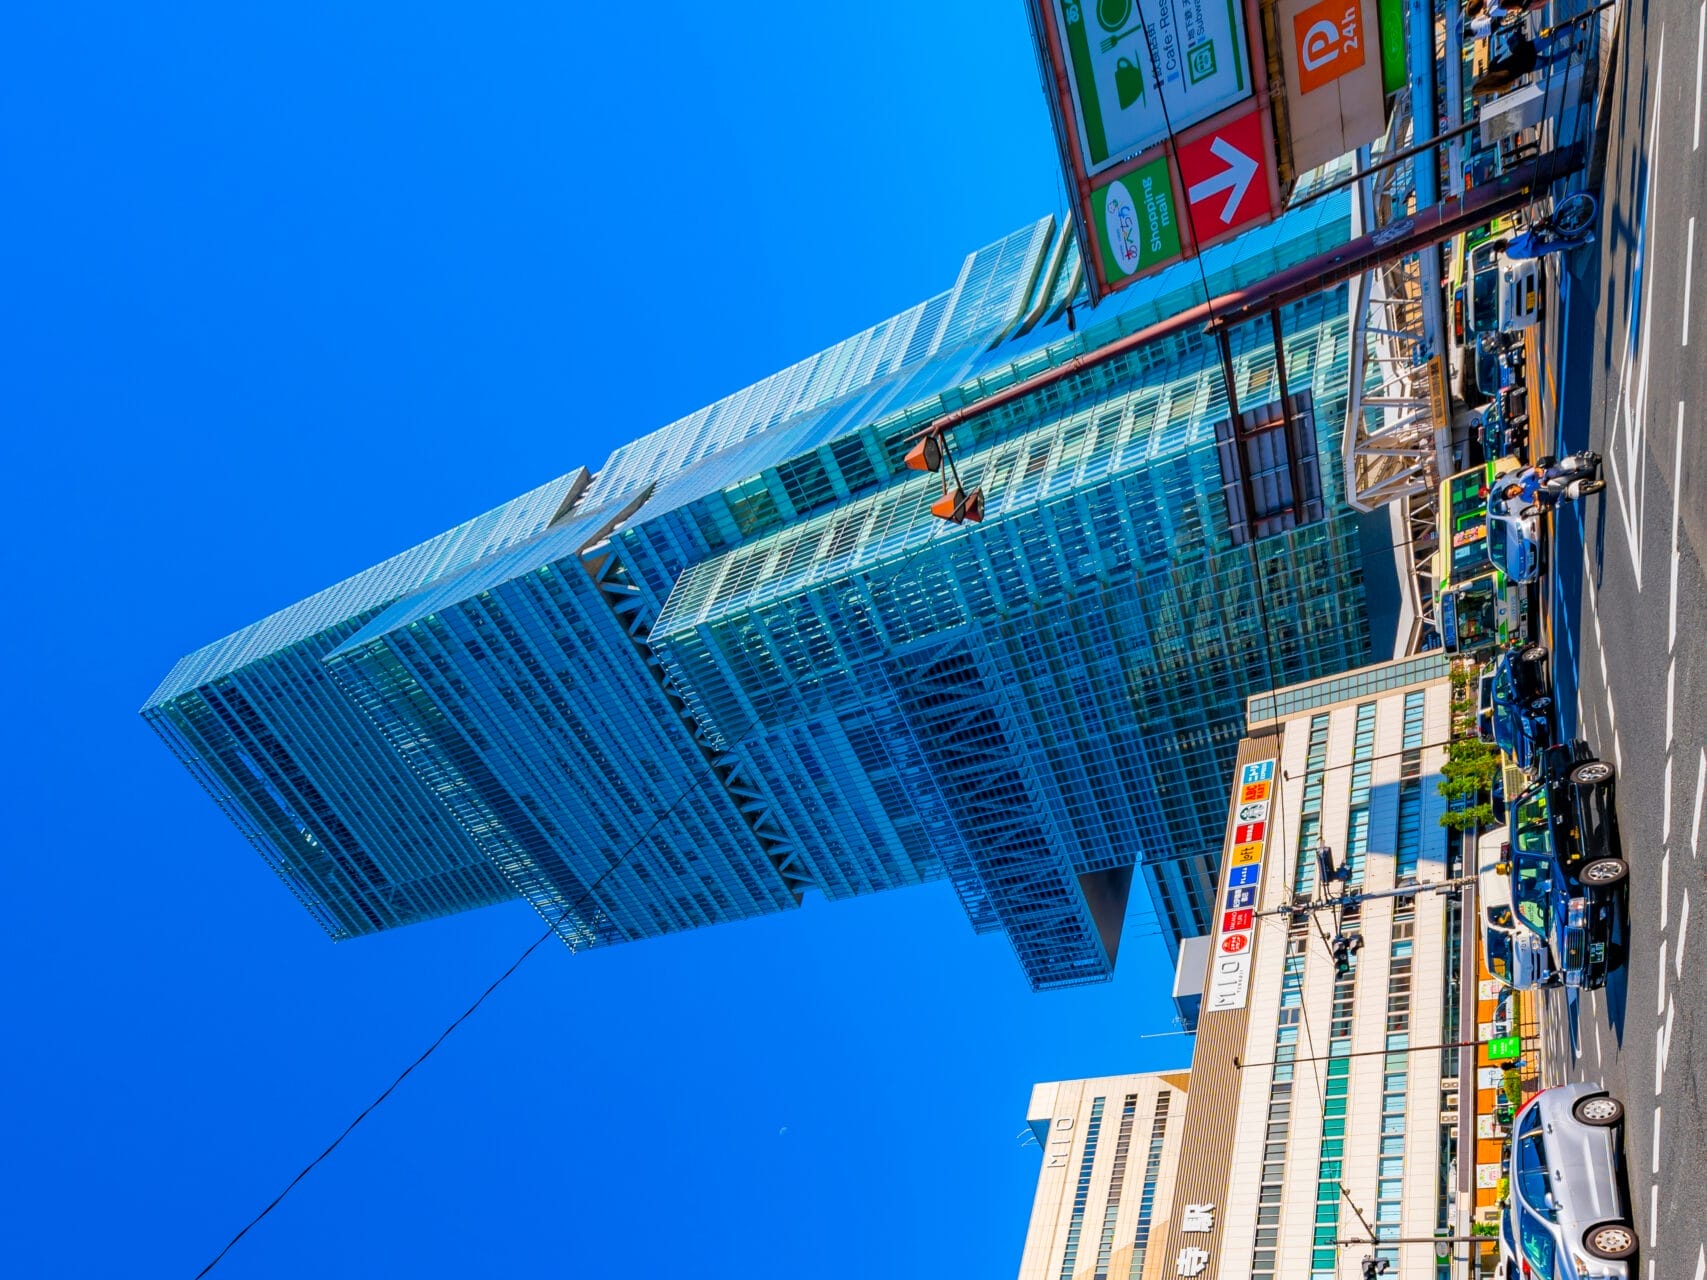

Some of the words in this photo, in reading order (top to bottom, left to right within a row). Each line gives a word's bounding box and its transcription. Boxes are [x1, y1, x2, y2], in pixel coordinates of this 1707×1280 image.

[1341, 7, 1358, 53] 24h
[1142, 176, 1162, 252] Shopping
[1155, 193, 1170, 227] mall
[1245, 785, 1257, 801] ABC
[1247, 764, 1260, 782] ニトリ
[1240, 867, 1248, 884] PLAZA
[1214, 961, 1240, 1007] MIO
[1046, 1117, 1075, 1169] MIO
